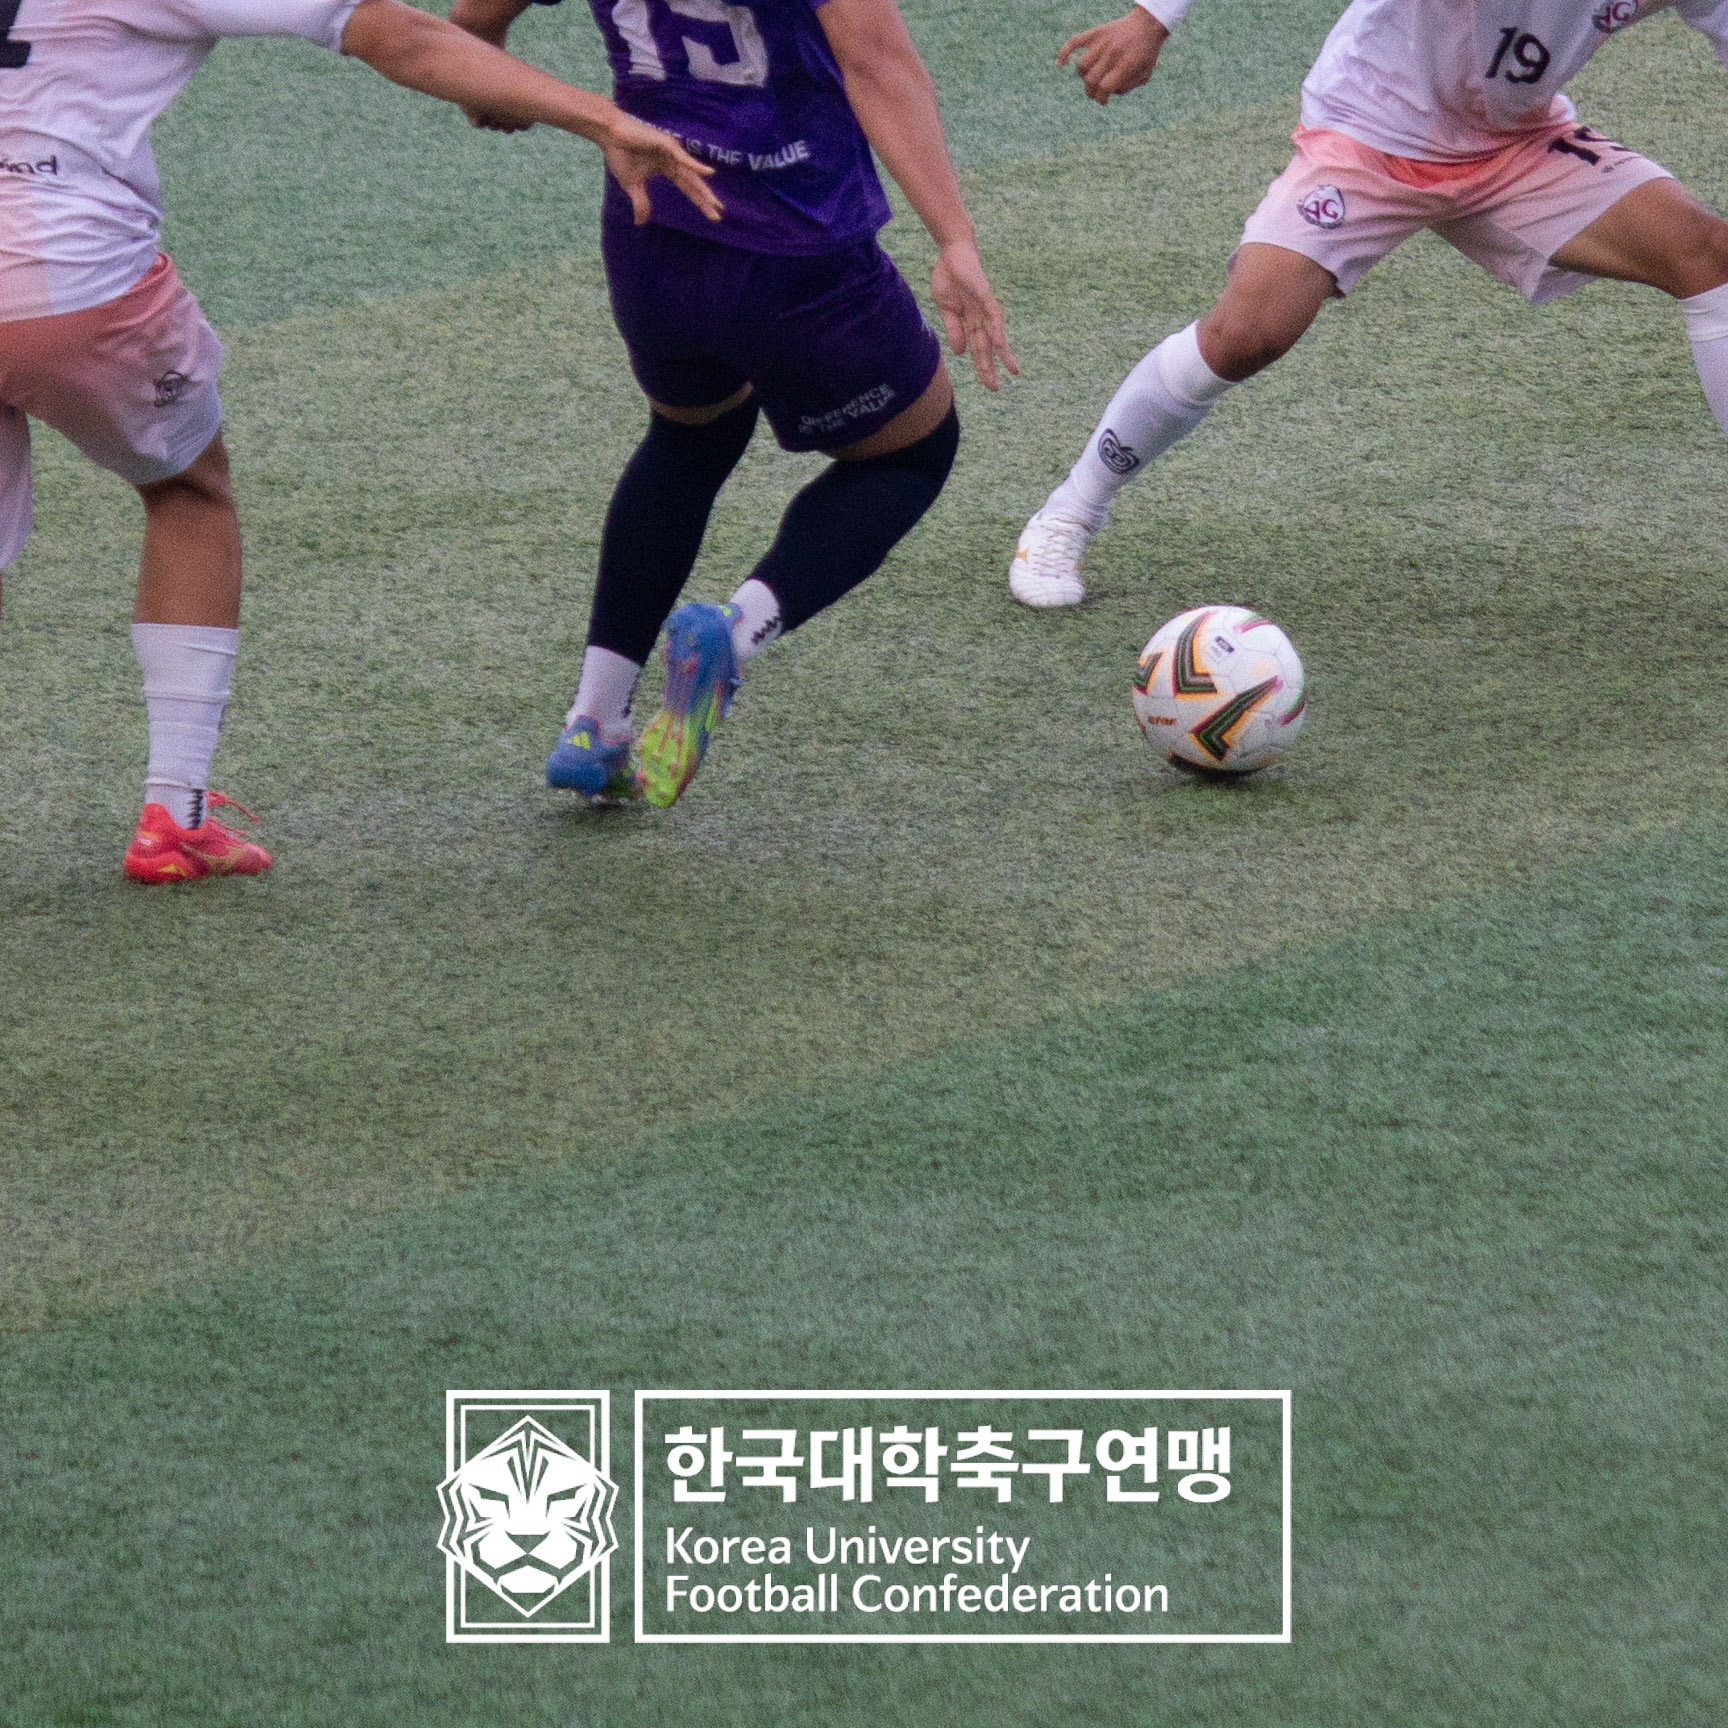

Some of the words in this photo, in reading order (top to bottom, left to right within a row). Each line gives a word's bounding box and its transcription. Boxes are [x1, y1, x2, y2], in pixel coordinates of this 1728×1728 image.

[1486, 26, 1551, 84] 19
[707, 143, 743, 166] THE
[748, 139, 812, 171] VALUE
